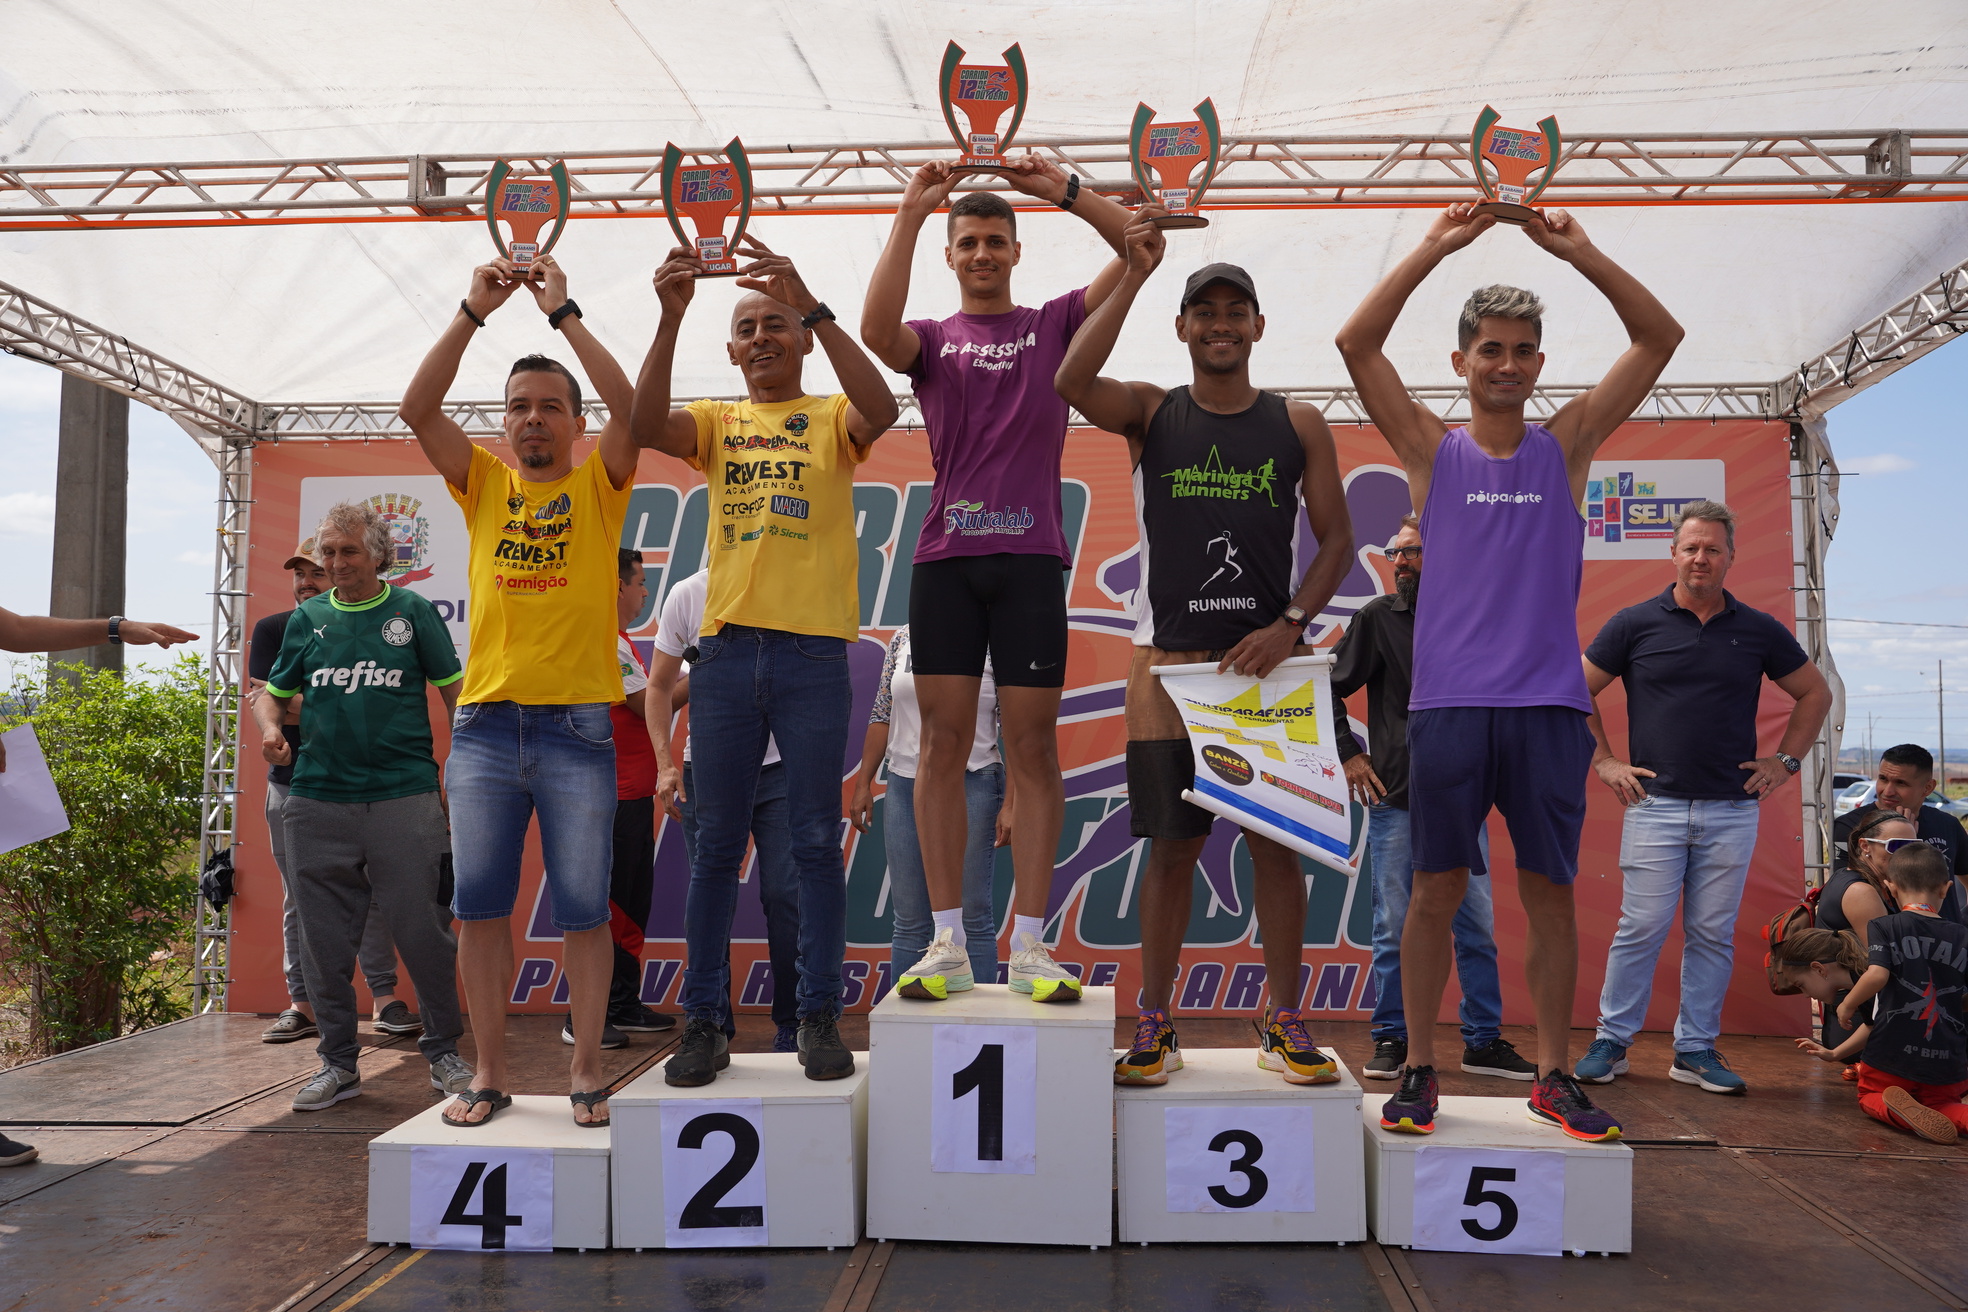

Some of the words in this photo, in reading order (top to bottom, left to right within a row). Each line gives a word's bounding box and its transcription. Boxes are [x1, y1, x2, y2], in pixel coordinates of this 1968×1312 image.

[960, 69, 989, 80] CORRIDA
[958, 80, 977, 99] 12
[1150, 127, 1180, 138] CORRIDA
[1493, 129, 1522, 141] CORRIDA
[1148, 138, 1168, 158] 12
[1488, 138, 1510, 155] 12
[975, 158, 1001, 167] LUGAR
[681, 169, 710, 182] CORRIDA
[505, 184, 533, 193] CORRIDA
[681, 181, 700, 203] 12
[501, 193, 521, 211] 12
[707, 261, 732, 271] UGAR
[725, 460, 806, 486] REVEST
[725, 481, 804, 495] ACABAMENTOS
[1172, 484, 1249, 500] Runners
[774, 496, 806, 518] MAGRO
[949, 506, 1034, 531] Nutralab
[961, 527, 994, 536] PRODUTOS
[494, 539, 567, 564] REVEST
[494, 560, 567, 572] ACABAMENTOS
[507, 575, 568, 592] amigão
[1189, 598, 1256, 613] RUNNING
[384, 629, 411, 644] PALMEIRAS
[311, 660, 403, 694] crefisa
[1182, 697, 1315, 718] MULTIPARAFUSOS
[1205, 749, 1250, 771] BANZÉ
[1275, 778, 1319, 802] TORNEARIA
[1319, 795, 1343, 812] NOVA
[1903, 1044, 1919, 1055] 4º
[1921, 1049, 1949, 1060] BPM
[952, 1044, 1004, 1161] 1
[677, 1112, 764, 1229] 2
[1206, 1129, 1269, 1208] 3
[440, 1162, 522, 1249] 4
[1460, 1166, 1519, 1242] 5
